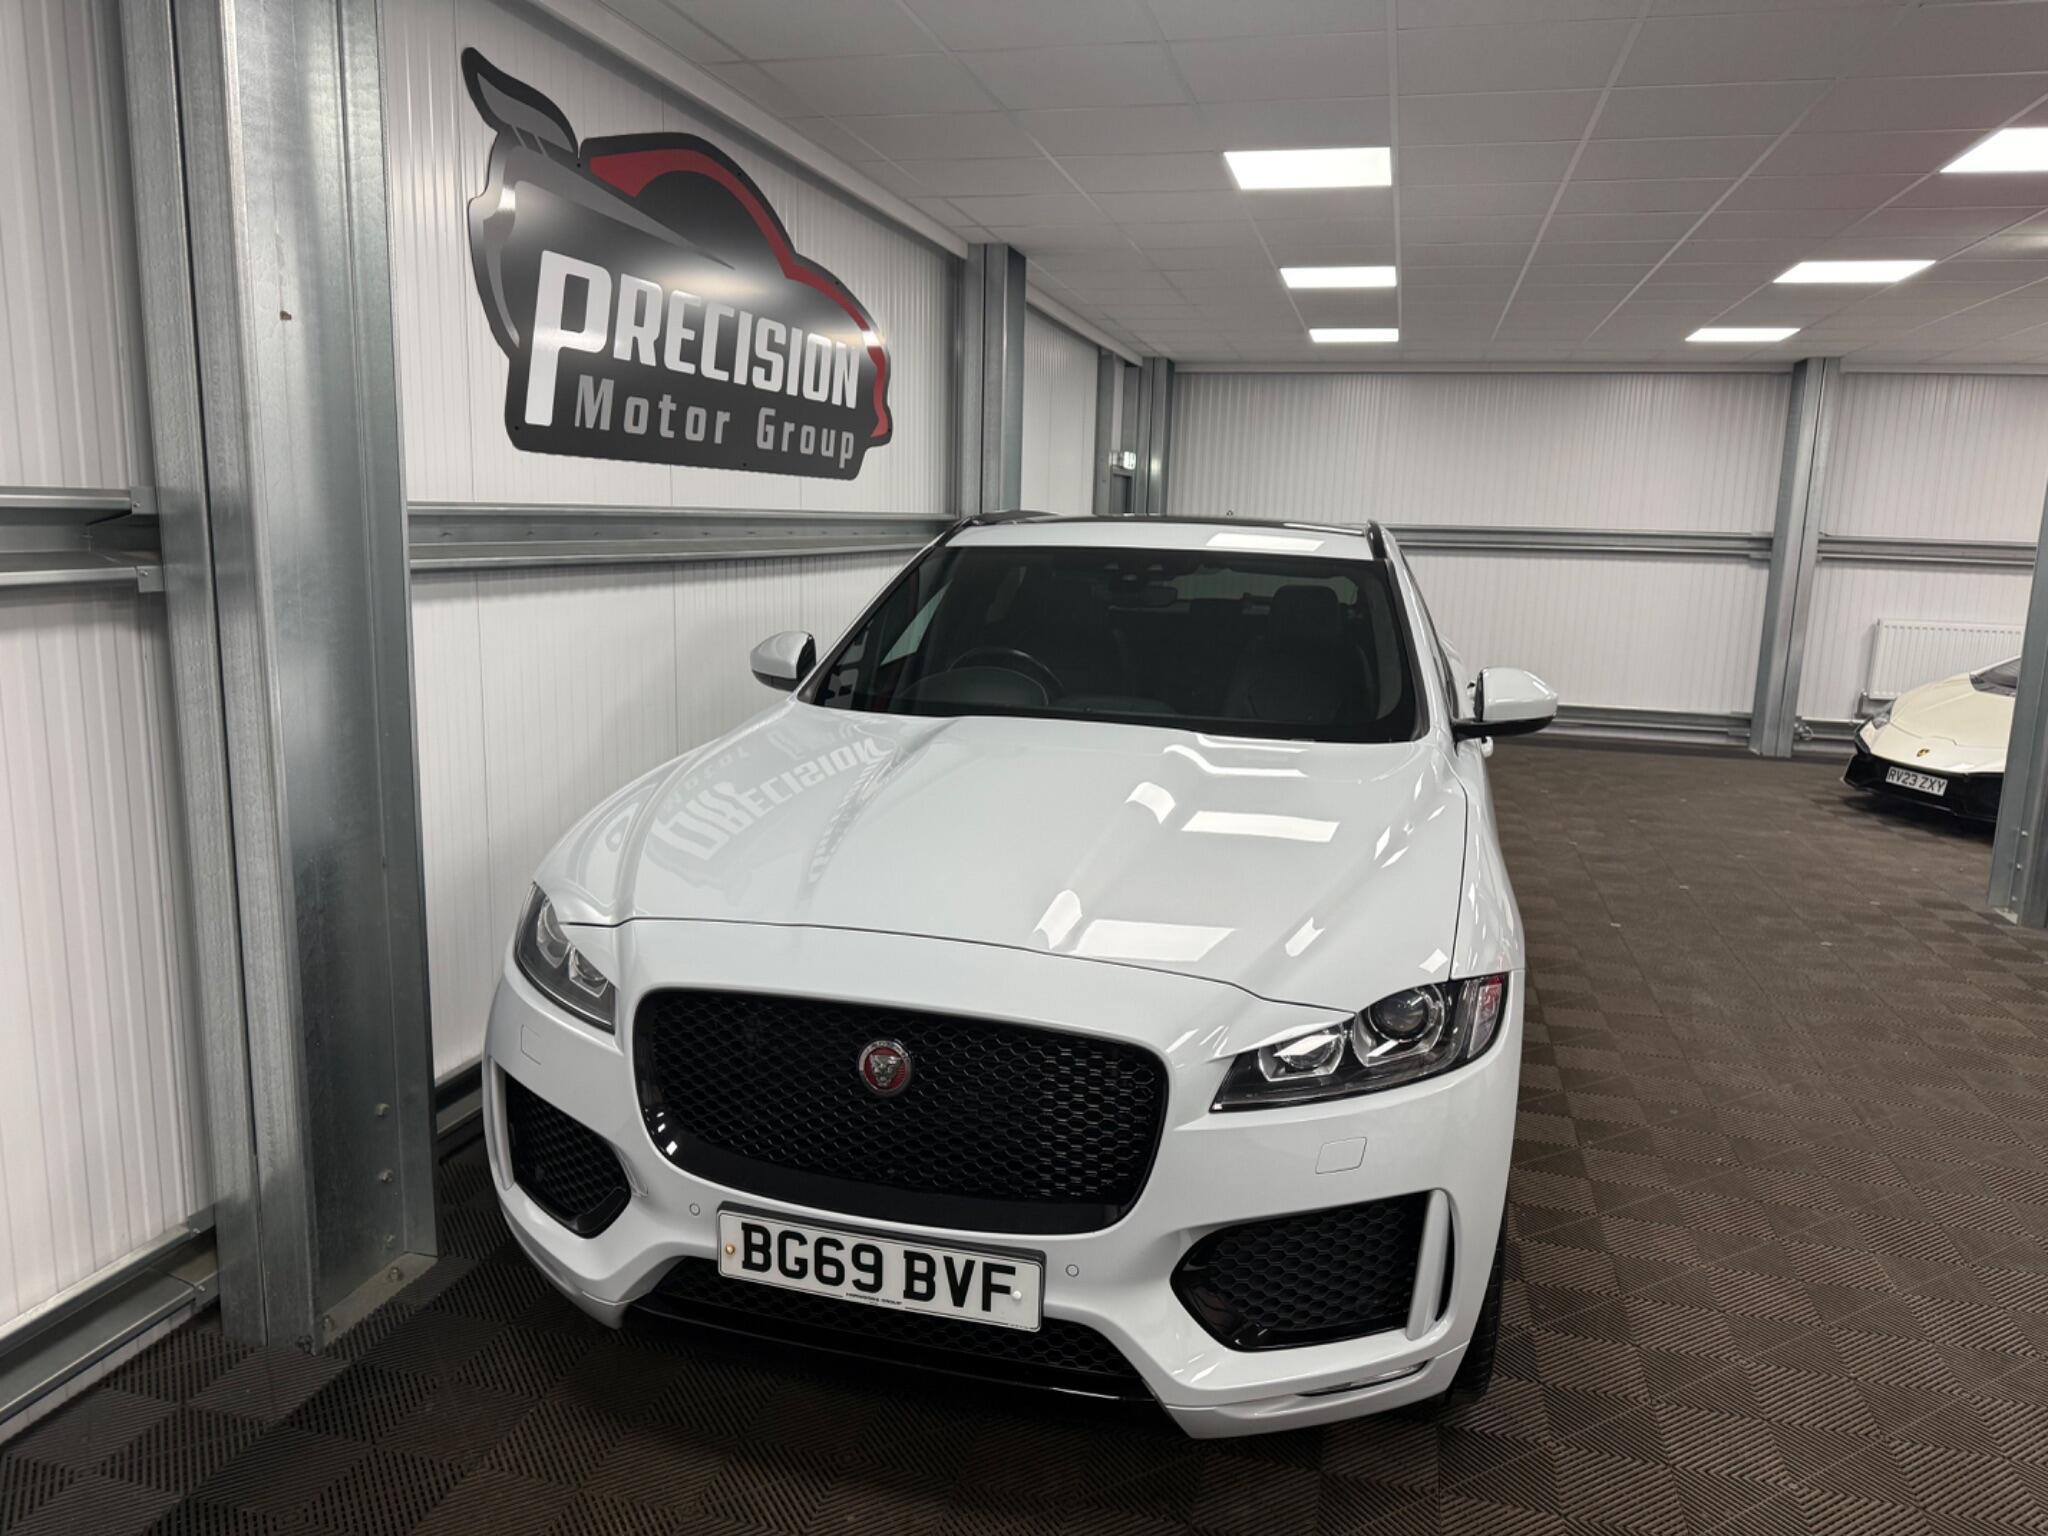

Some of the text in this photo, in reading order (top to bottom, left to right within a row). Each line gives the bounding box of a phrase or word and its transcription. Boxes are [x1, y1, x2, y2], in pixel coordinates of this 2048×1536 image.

[525, 250, 860, 427] PRECISION
[574, 374, 855, 468] Motor Group
[1889, 768, 1946, 792] RV23 ZXY
[741, 1222, 1017, 1313] BG69 BVF
